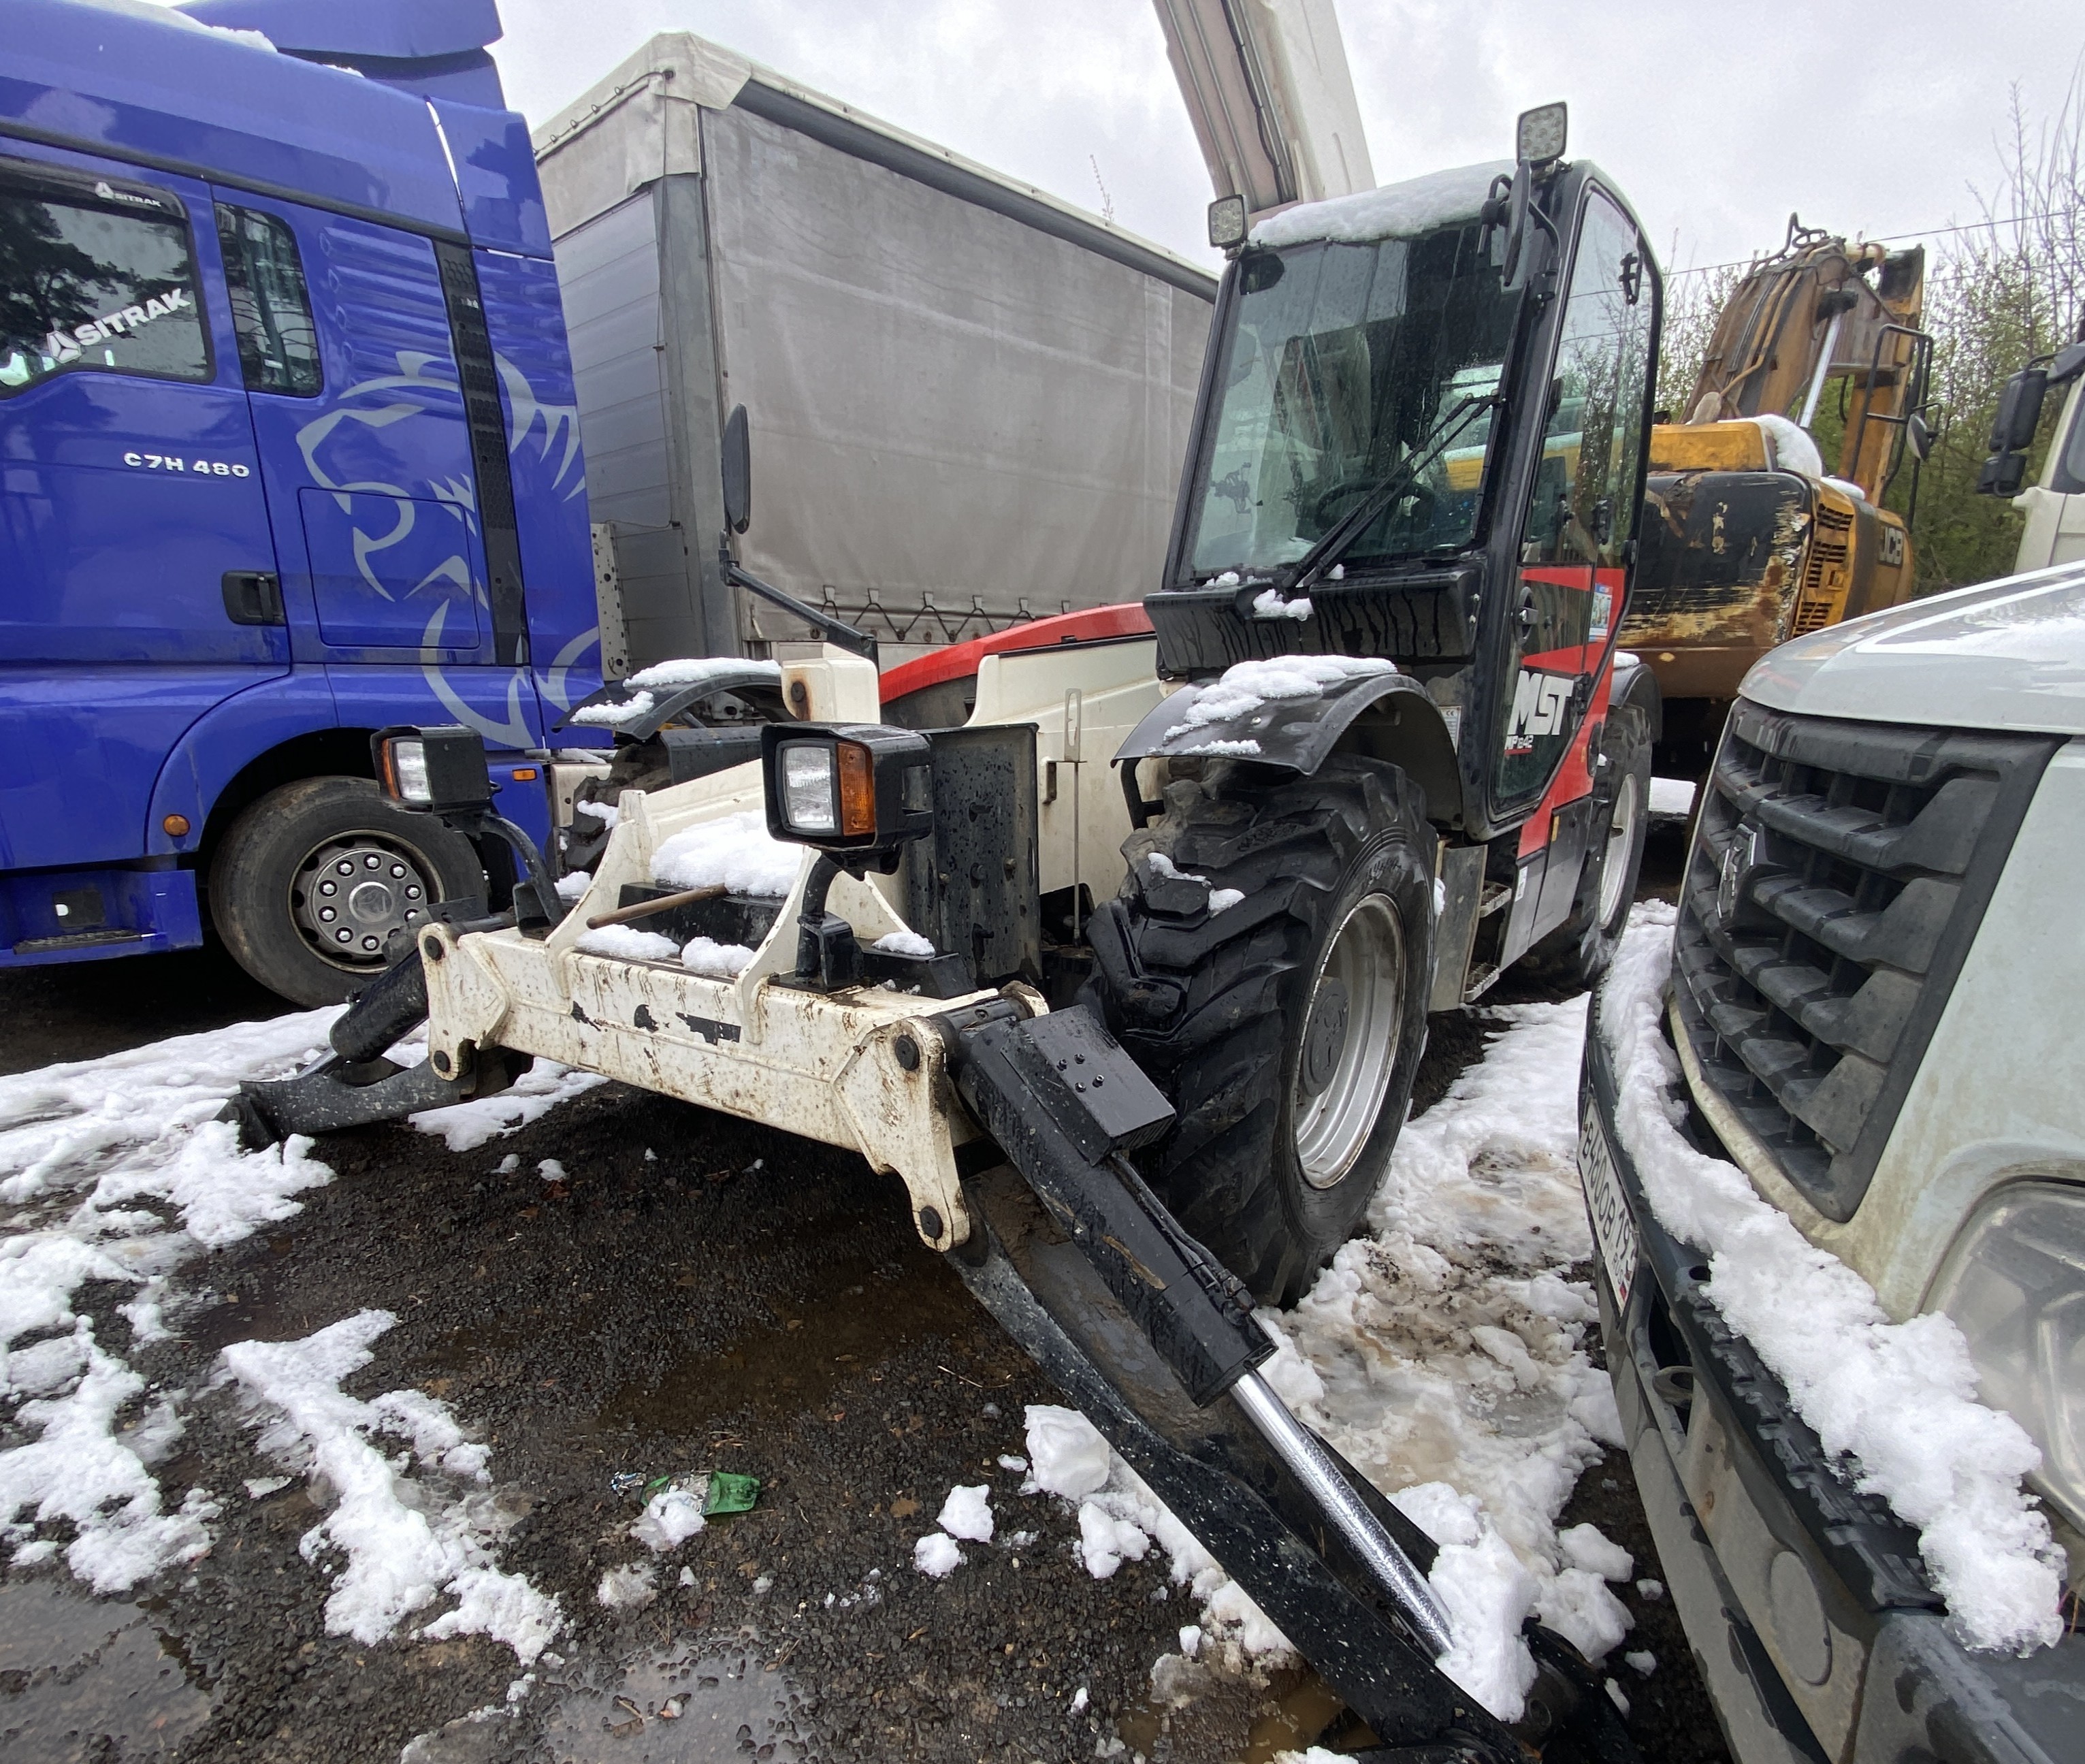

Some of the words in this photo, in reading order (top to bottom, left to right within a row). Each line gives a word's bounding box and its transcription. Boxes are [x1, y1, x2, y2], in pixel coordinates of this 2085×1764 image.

[114, 193, 162, 207] SITRAK
[74, 288, 191, 346] SITRAK
[124, 452, 184, 472] C7H
[193, 460, 250, 477] 480
[1879, 526, 1903, 565] JCB
[1506, 669, 1574, 736] MST
